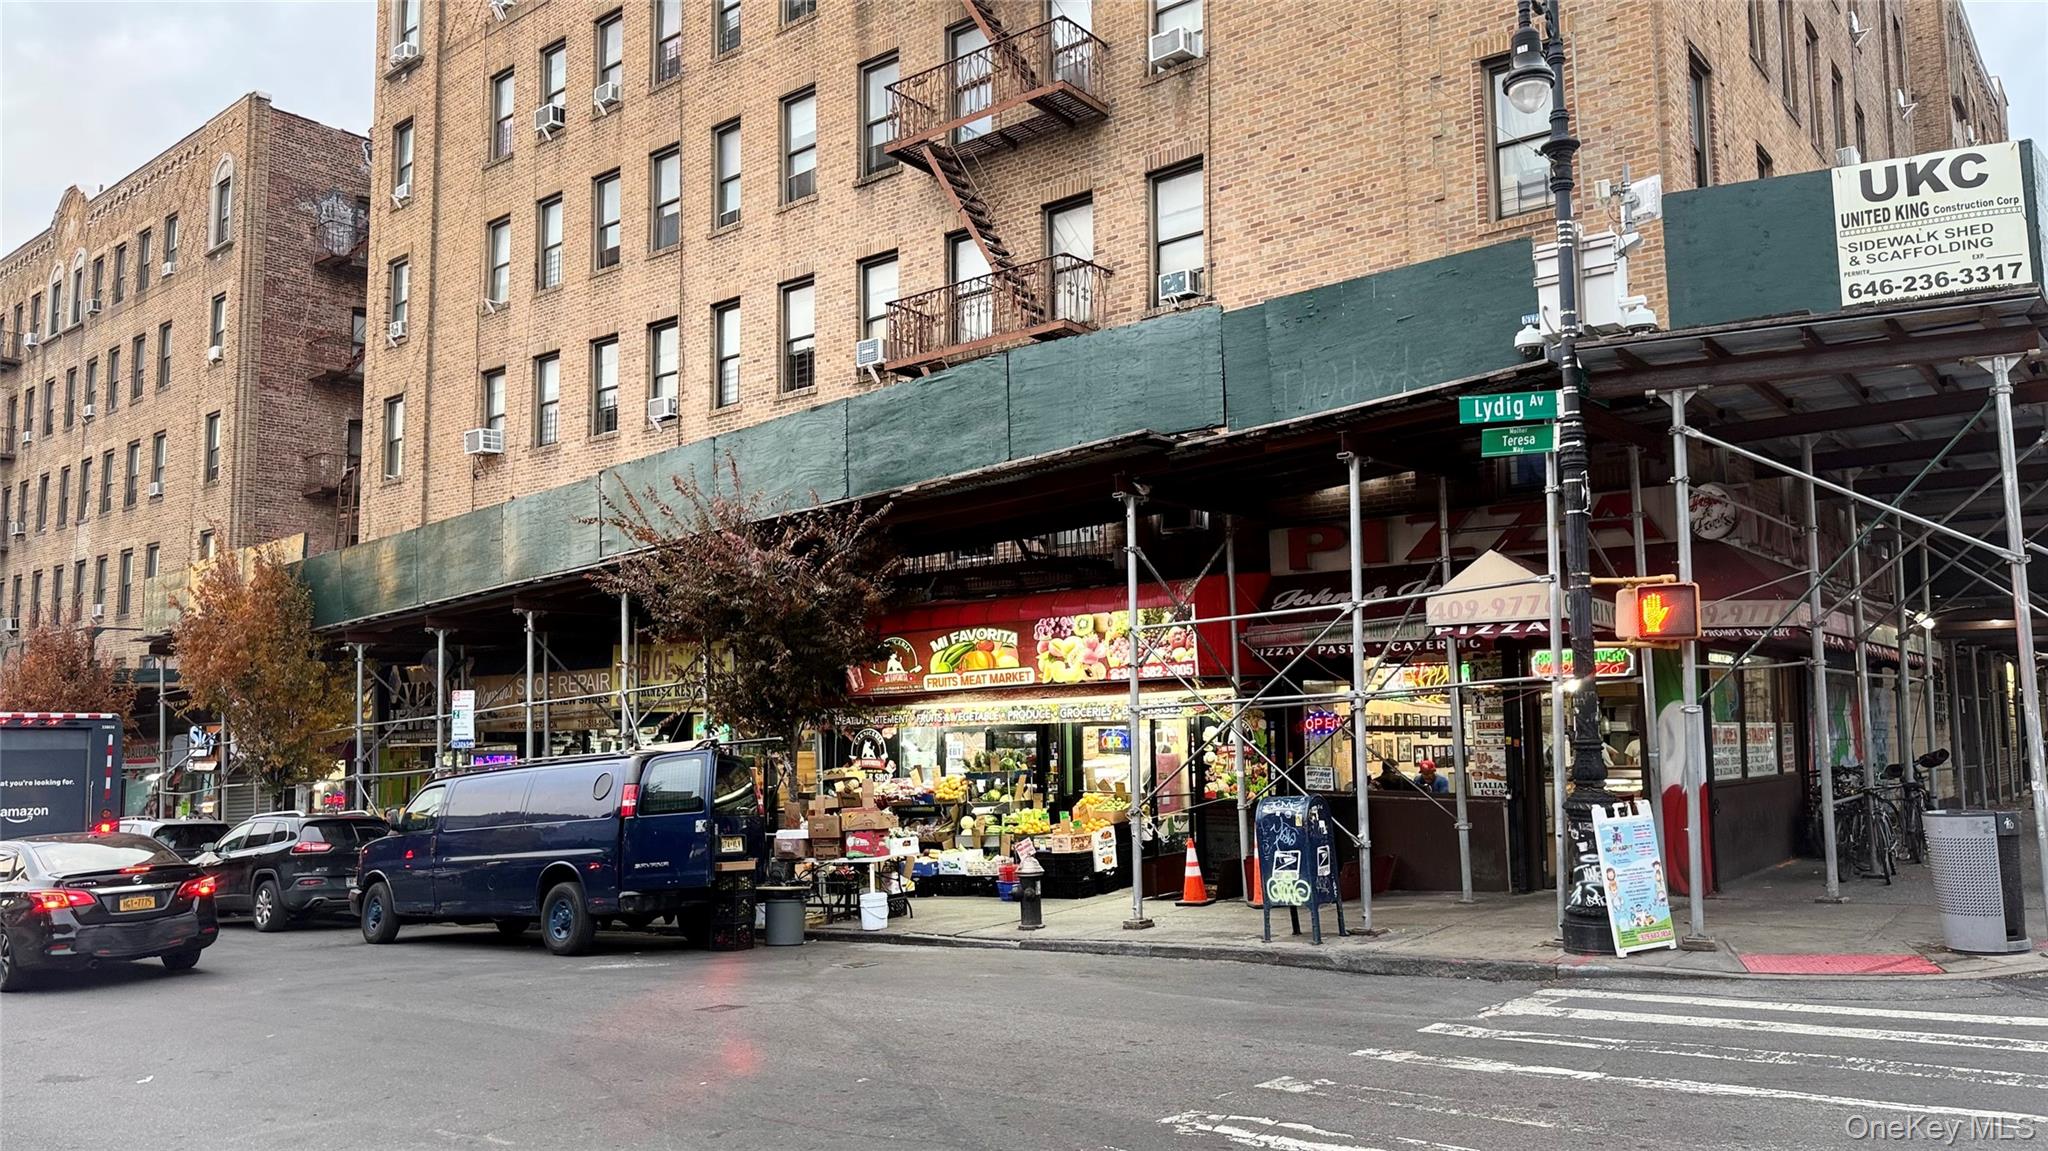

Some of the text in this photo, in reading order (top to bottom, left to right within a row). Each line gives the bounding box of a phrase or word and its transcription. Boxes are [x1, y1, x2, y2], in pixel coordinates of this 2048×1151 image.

[1859, 152, 1989, 203] UKC
[1840, 196, 2020, 228] UNITED KING Construction Corp
[1847, 223, 1994, 253] SIDEWALK SHED
[1848, 236, 1993, 267] & SCAFFOLDING
[1847, 261, 2023, 299] 646-236-3317
[1474, 394, 1544, 423] Lydig Av
[1501, 435, 1536, 447] Teresa
[1287, 493, 1665, 571] PIZZA
[929, 627, 1019, 653] MI FAVORITA
[1435, 621, 1549, 638] PIZZA
[515, 676, 554, 697] SOE
[558, 672, 611, 695] REPAIR
[926, 671, 1032, 689] FRUITS MEAT MARKET
[915, 713, 942, 724] FRUITS
[952, 711, 1000, 723] VEGETABLE
[1007, 708, 1053, 722] PRODUCE
[1059, 706, 1113, 720] GROCERIES
[1304, 717, 1340, 730] OPEN
[10, 778, 33, 789] you're
[33, 778, 59, 788] looking
[59, 778, 75, 787] for.
[0, 805, 49, 818] amazon
